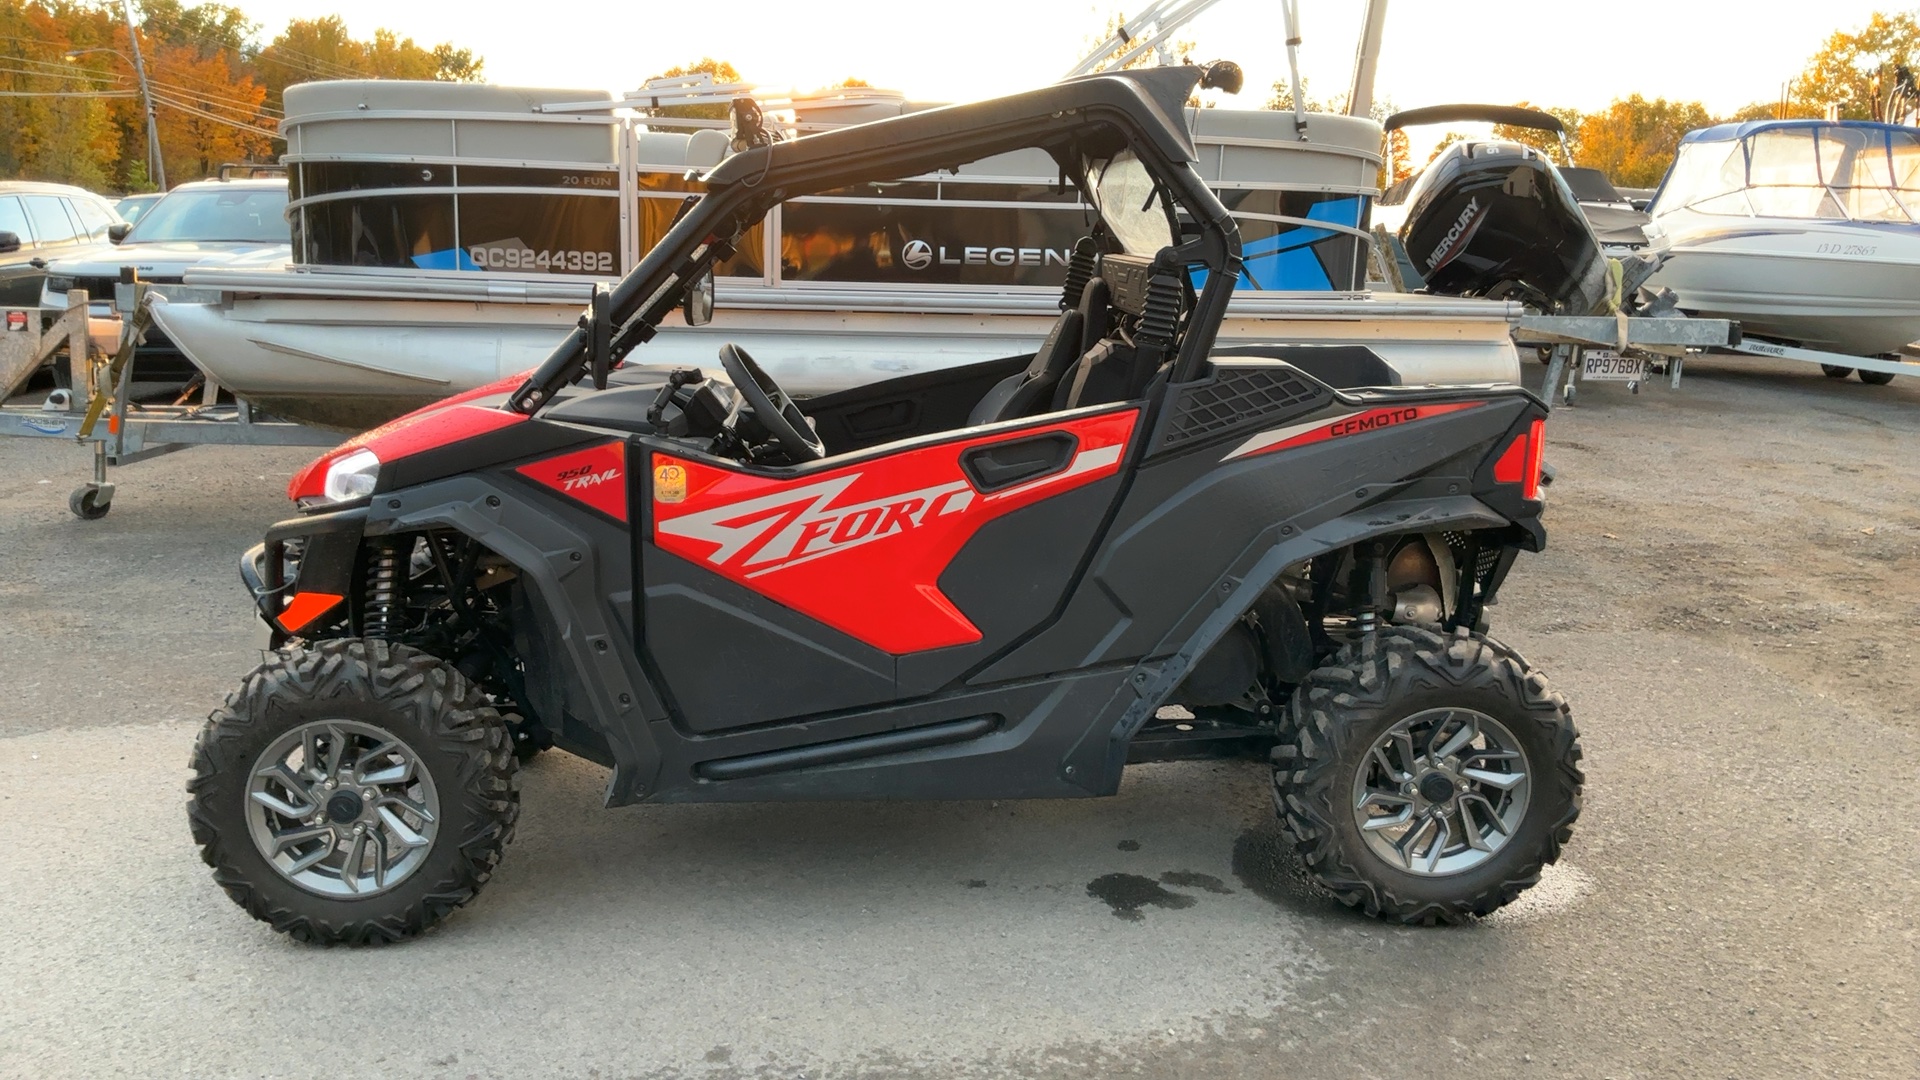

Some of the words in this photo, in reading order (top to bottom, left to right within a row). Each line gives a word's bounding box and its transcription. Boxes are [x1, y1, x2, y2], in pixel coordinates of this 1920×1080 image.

[562, 175, 580, 185] 20
[584, 176, 612, 186] FUN
[1425, 195, 1480, 270] MERCURY
[470, 247, 613, 272] QC9244392
[939, 246, 1099, 267] LEGEN
[1830, 243, 1842, 255] D
[1843, 244, 1878, 257] 27865
[1585, 357, 1643, 375] RP9768X
[1330, 407, 1418, 437] CFMOTO
[556, 464, 593, 481] 950
[563, 468, 622, 491] TRAIL
